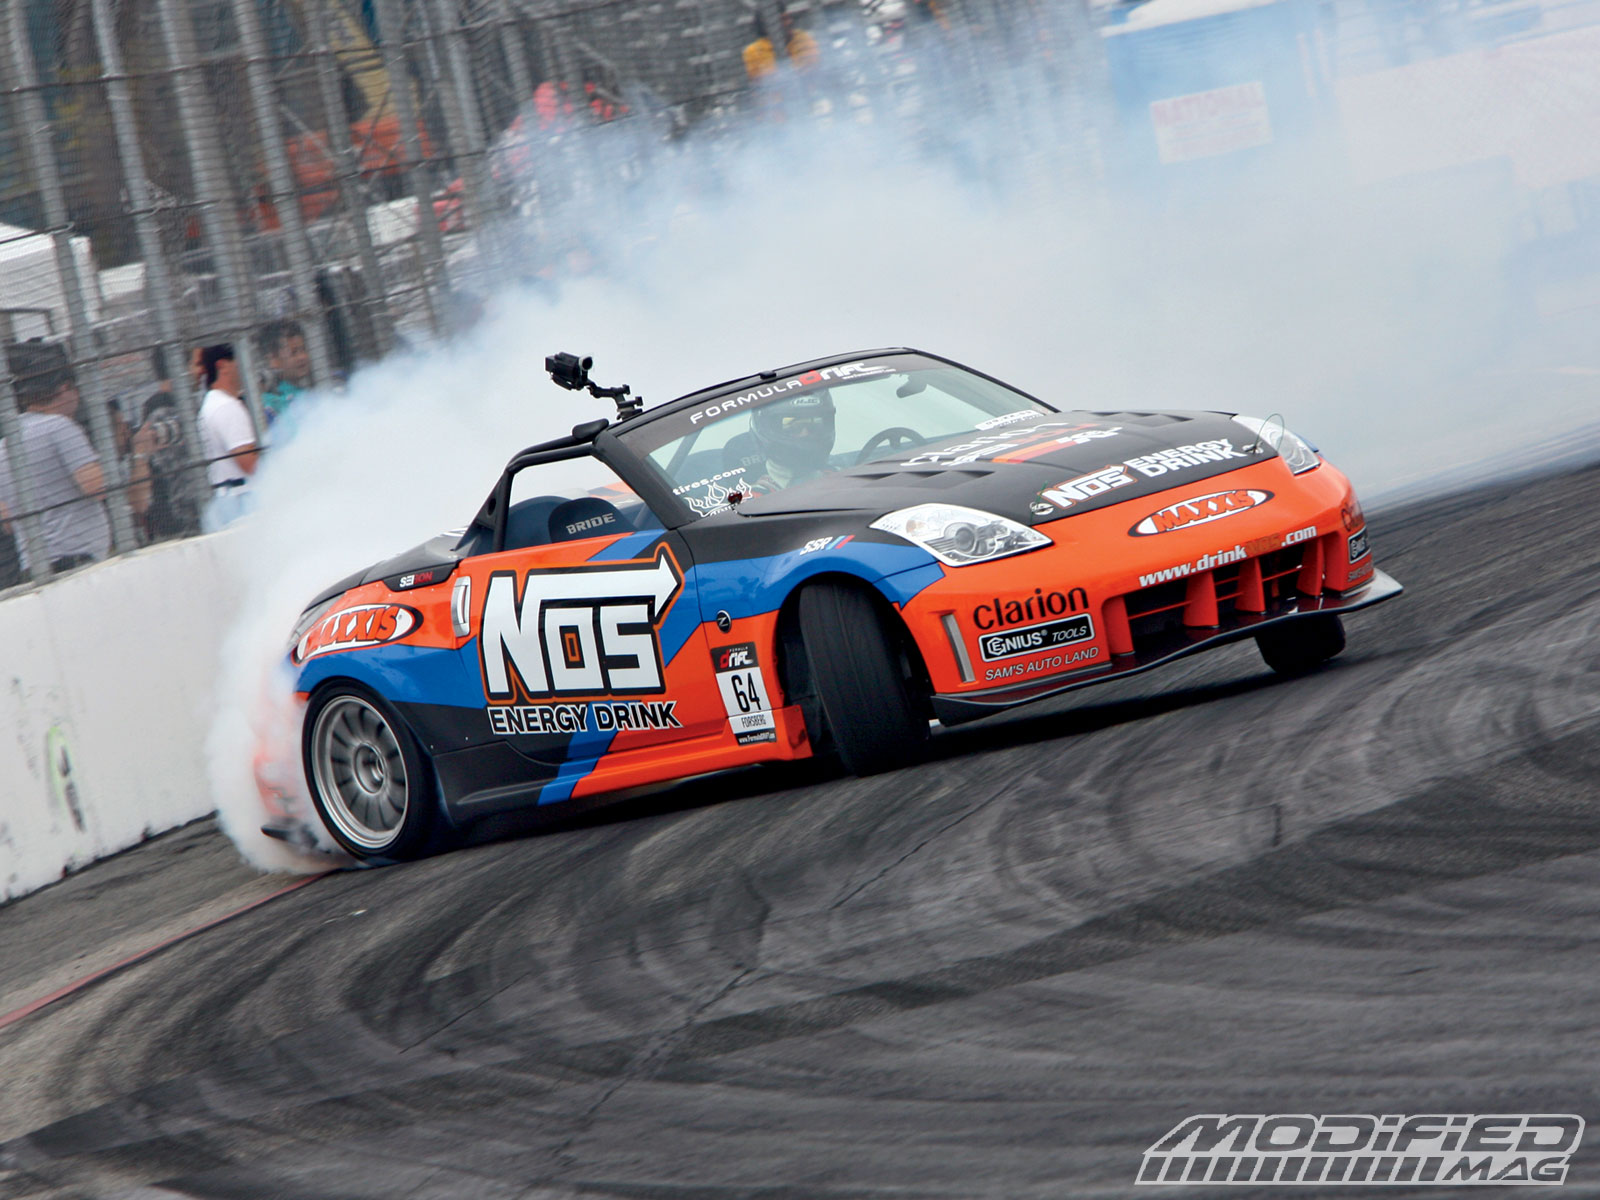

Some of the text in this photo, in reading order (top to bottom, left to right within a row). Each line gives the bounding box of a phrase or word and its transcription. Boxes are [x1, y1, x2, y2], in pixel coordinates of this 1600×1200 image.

[690, 379, 802, 424] FORMULA
[1122, 438, 1233, 468] ENERGY
[1137, 448, 1247, 478] DRINK
[1041, 465, 1135, 508] NOS
[566, 513, 616, 535] BRIDE
[1150, 489, 1256, 533] MAXXIS
[482, 554, 678, 693] NOS
[973, 587, 1089, 630] clarion
[1052, 625, 1087, 642] TOOLS
[985, 647, 1099, 681] SAM'S AUTO LAND
[731, 672, 762, 713] 64
[487, 701, 684, 735] ENERGY DRINK
[741, 714, 767, 728] FORSBERG
